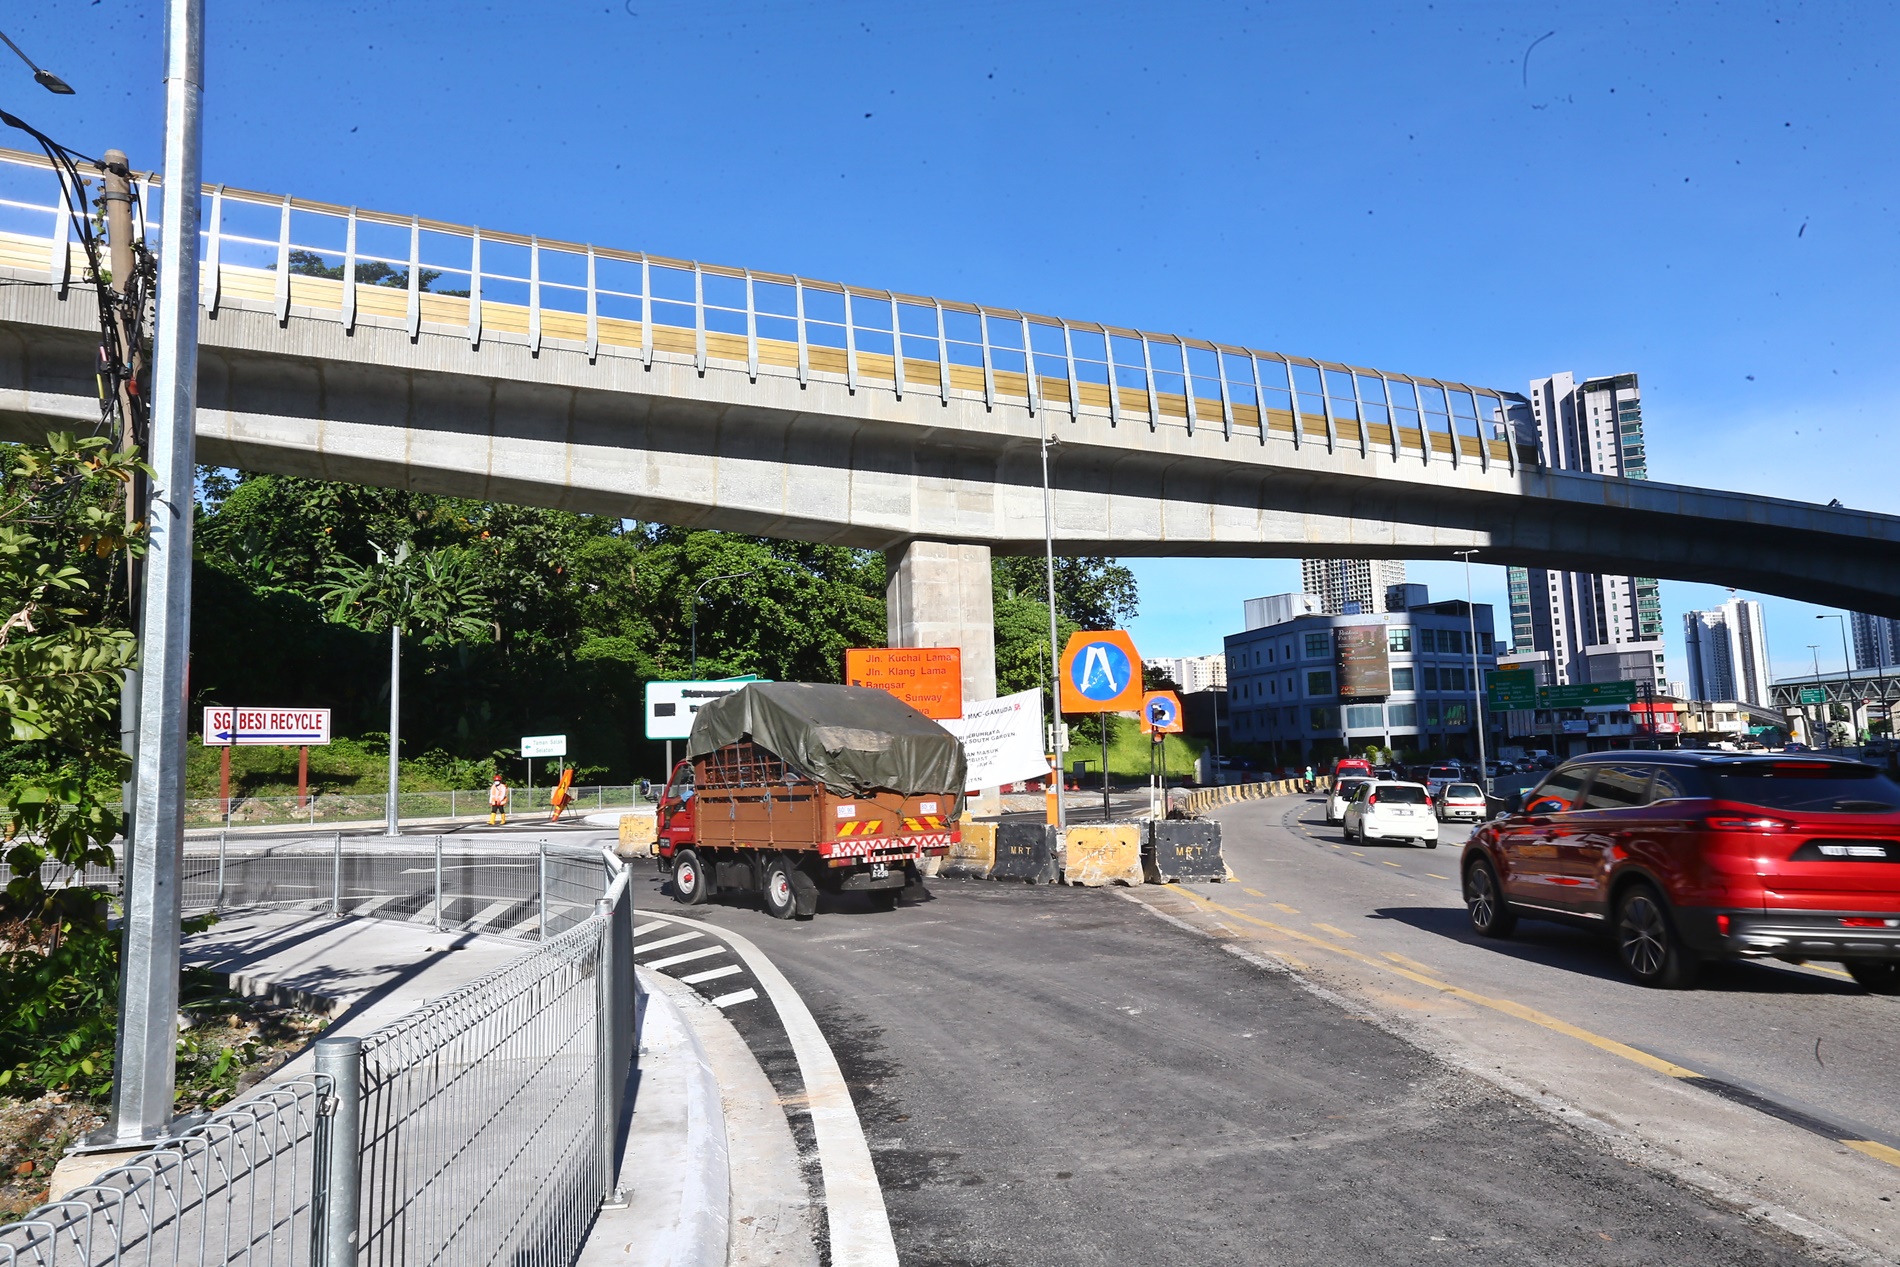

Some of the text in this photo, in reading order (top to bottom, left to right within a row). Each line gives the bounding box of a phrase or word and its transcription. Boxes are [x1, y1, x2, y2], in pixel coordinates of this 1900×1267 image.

[866, 654, 952, 663] Jln. Kuchai Lama
[866, 667, 947, 677] Jln. Klang Lama
[866, 682, 905, 691] Bangsar
[905, 694, 942, 703] Sunway
[213, 712, 323, 730] SG. BESI RECYCLE
[1010, 846, 1032, 855] MRT
[1085, 849, 1117, 859] MRT
[1175, 846, 1203, 856] MRT
